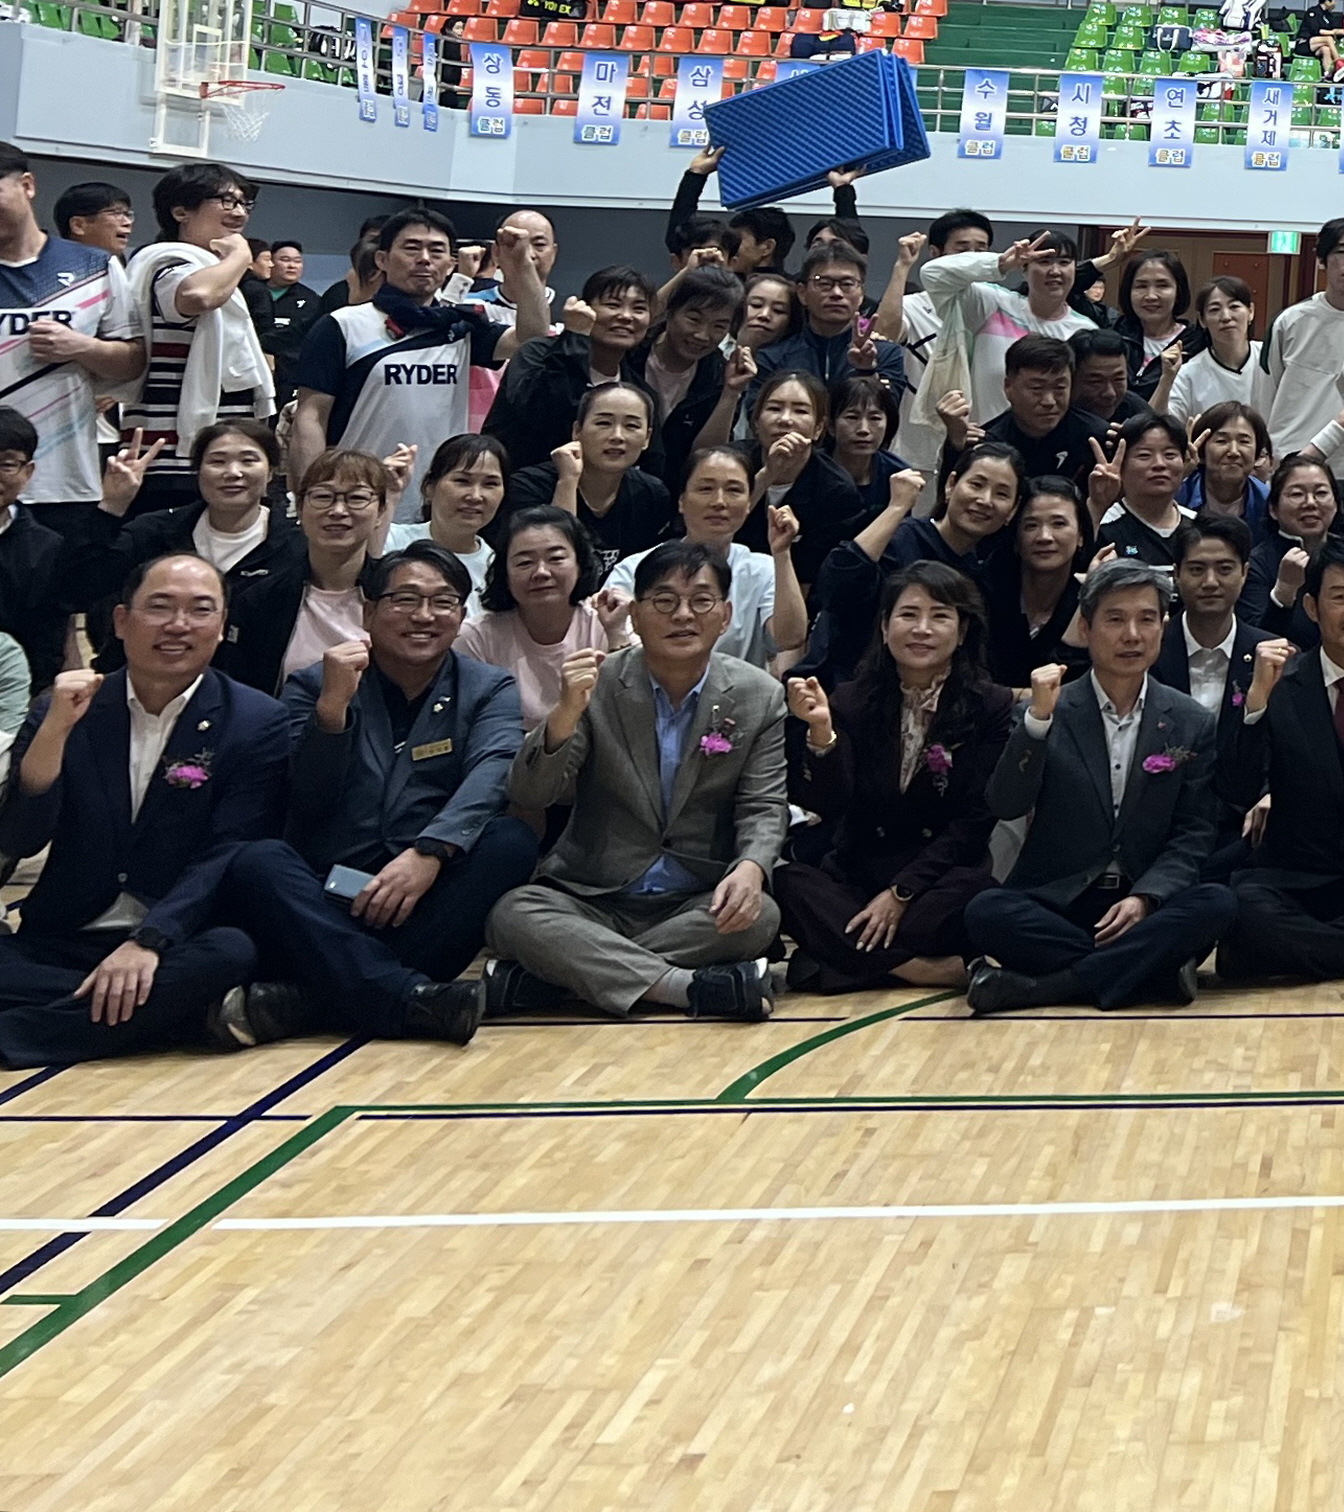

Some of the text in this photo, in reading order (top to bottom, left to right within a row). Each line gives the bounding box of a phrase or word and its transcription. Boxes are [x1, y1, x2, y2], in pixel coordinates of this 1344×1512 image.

[484, 52, 502, 108] 상동
[591, 62, 615, 117] 마전
[974, 78, 995, 130] 수월
[1069, 83, 1090, 136] 시청
[1163, 87, 1185, 140] 연초
[478, 117, 504, 133] 클럽
[1261, 88, 1282, 146] 새거제
[582, 125, 611, 141] 클럽
[678, 128, 707, 144] 클럽
[965, 140, 995, 156] 클럽
[1060, 145, 1090, 161] 클럽
[1155, 148, 1185, 164] 클럽
[1252, 152, 1281, 167] 클럽
[384, 364, 458, 386] RYDER
